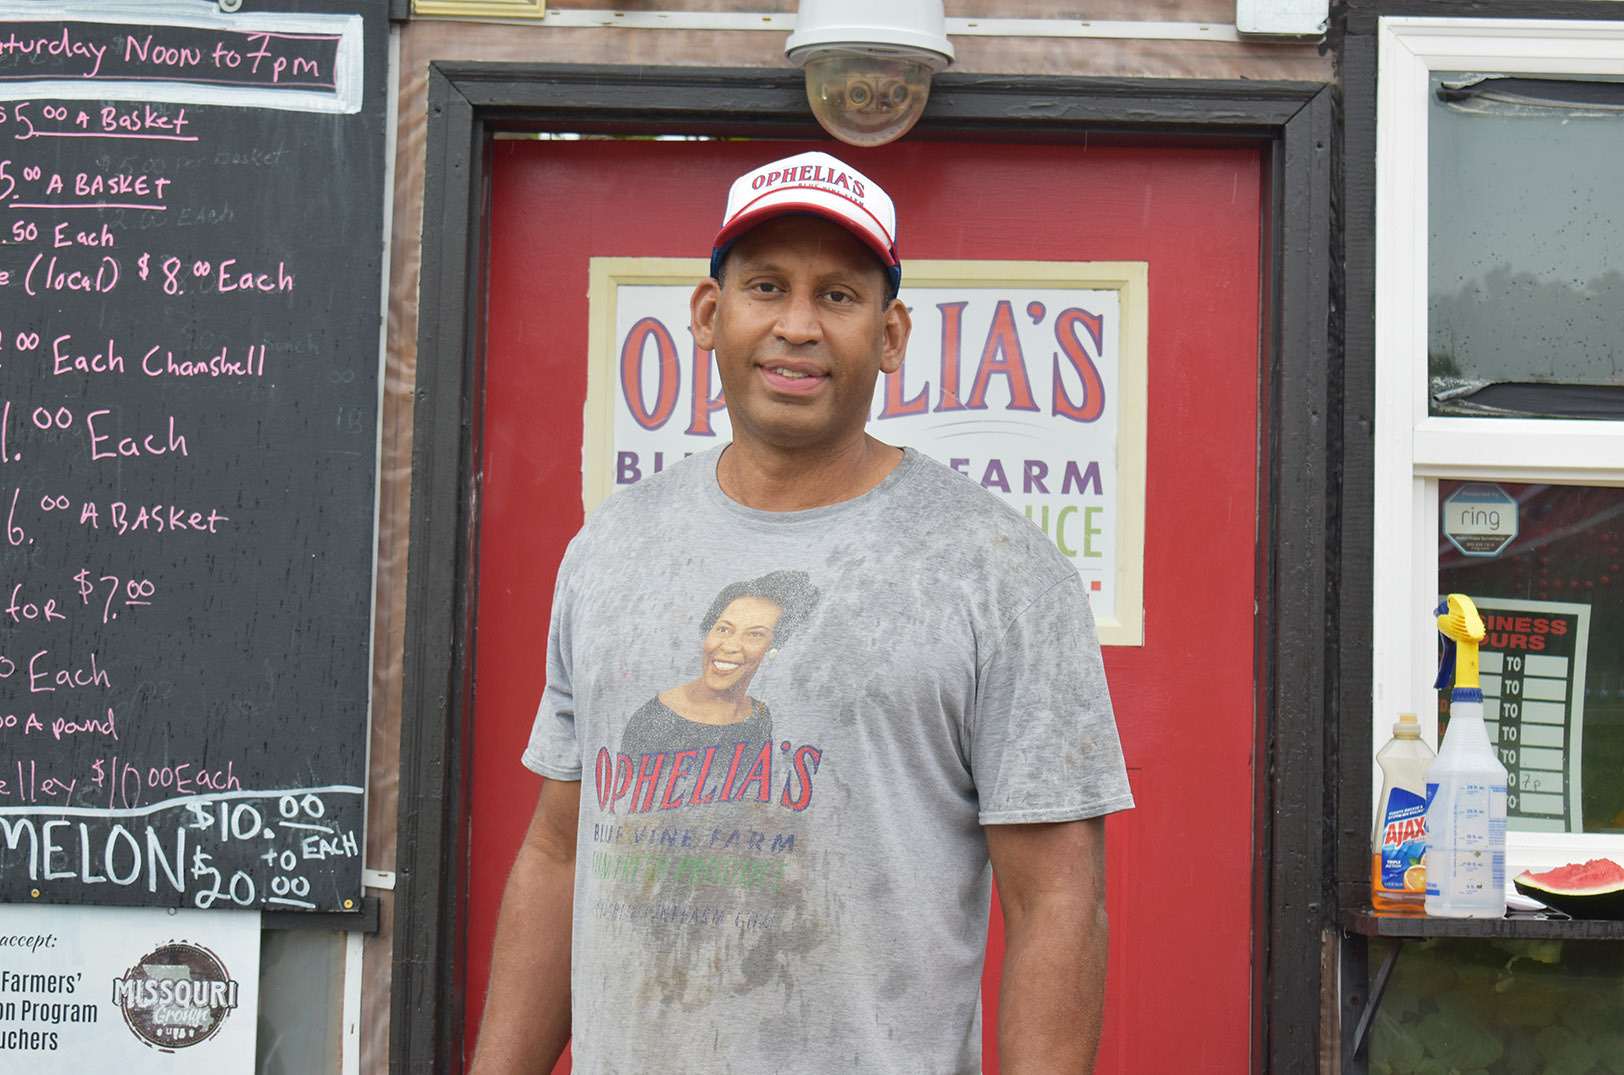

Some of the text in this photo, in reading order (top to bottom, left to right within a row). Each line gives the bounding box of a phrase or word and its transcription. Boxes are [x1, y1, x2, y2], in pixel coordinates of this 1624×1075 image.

[212, 42, 241, 67] to
[76, 114, 89, 128] A
[101, 105, 189, 134] Basket
[47, 174, 63, 195] A
[751, 165, 866, 199] OPHELIA'S
[54, 222, 114, 248] Each
[217, 259, 293, 292] Each
[53, 334, 125, 375] Each
[87, 410, 188, 461] Each
[80, 502, 99, 529] A
[1461, 507, 1500, 531] ring
[29, 650, 111, 692] Each
[1507, 656, 1522, 671] TO
[1505, 680, 1520, 694] TO
[25, 713, 43, 735] A
[52, 708, 119, 740] pound
[1503, 703, 1518, 718] TO
[1502, 727, 1517, 741] TO
[1502, 750, 1516, 764] TO
[176, 763, 243, 794] Each
[595, 739, 823, 815] OPHELIA'S
[1507, 773, 1516, 787] O
[302, 830, 359, 860] EACH
[709, 829, 796, 853] FARM
[1384, 815, 1426, 848] AJAX
[0, 817, 186, 893] MELON
[112, 977, 239, 1009] MISSOURI
[21, 1000, 98, 1025] Program
